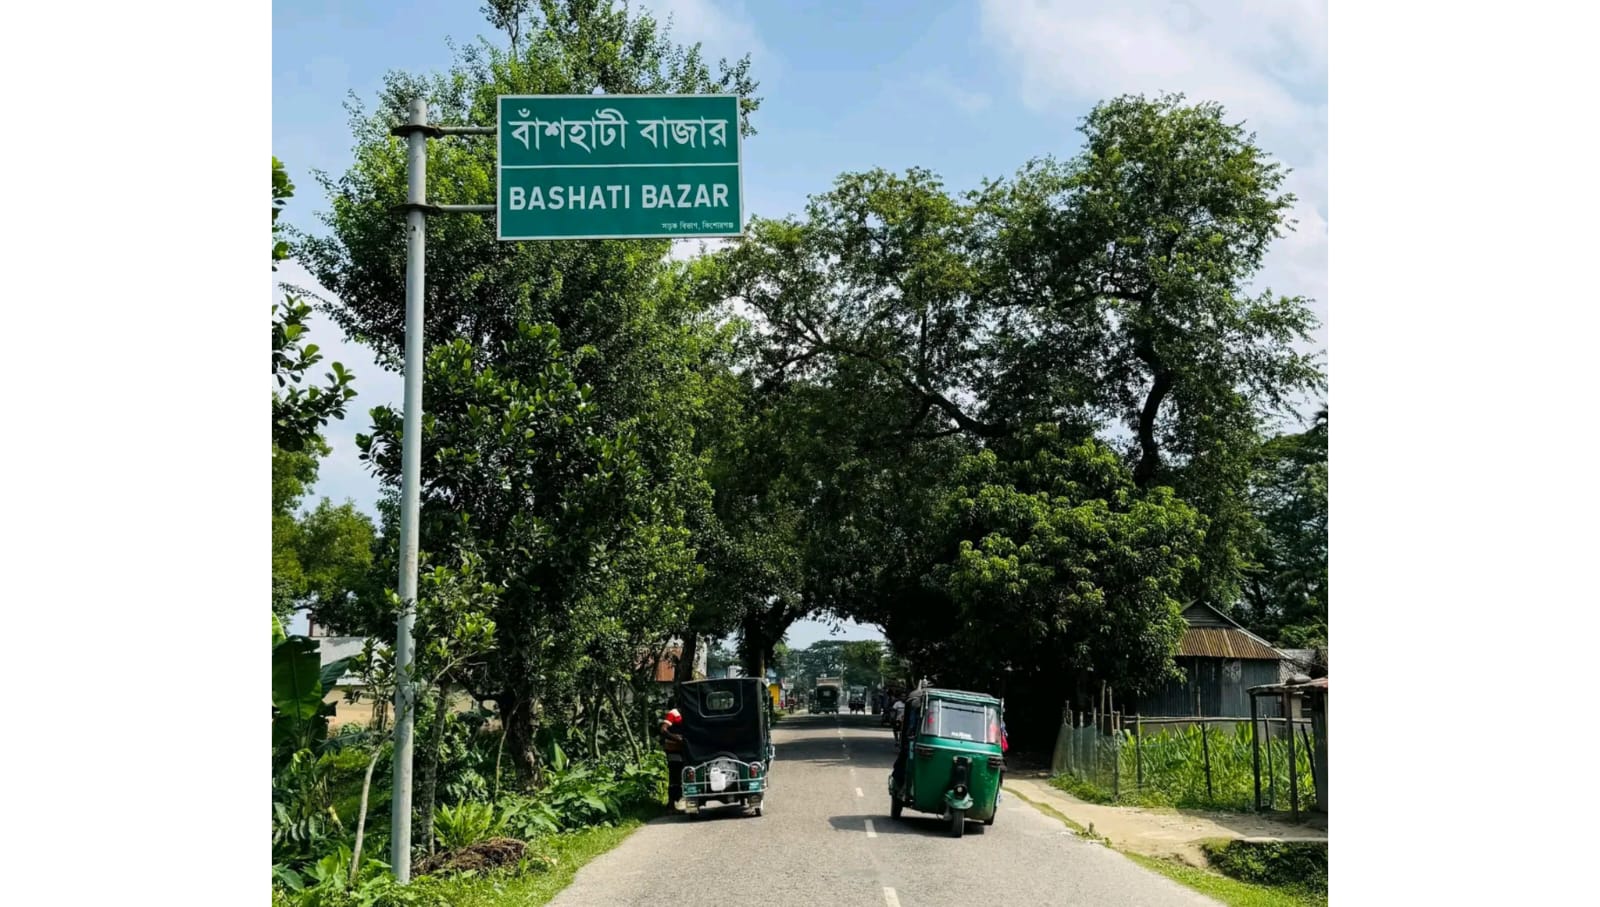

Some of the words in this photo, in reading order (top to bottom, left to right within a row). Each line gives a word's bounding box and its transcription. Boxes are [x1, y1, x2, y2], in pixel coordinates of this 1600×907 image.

[508, 108, 628, 153] বাঁশহাটী
[636, 115, 728, 149] বাজার
[509, 185, 630, 210] BASHATI
[641, 183, 729, 208] BAZAR
